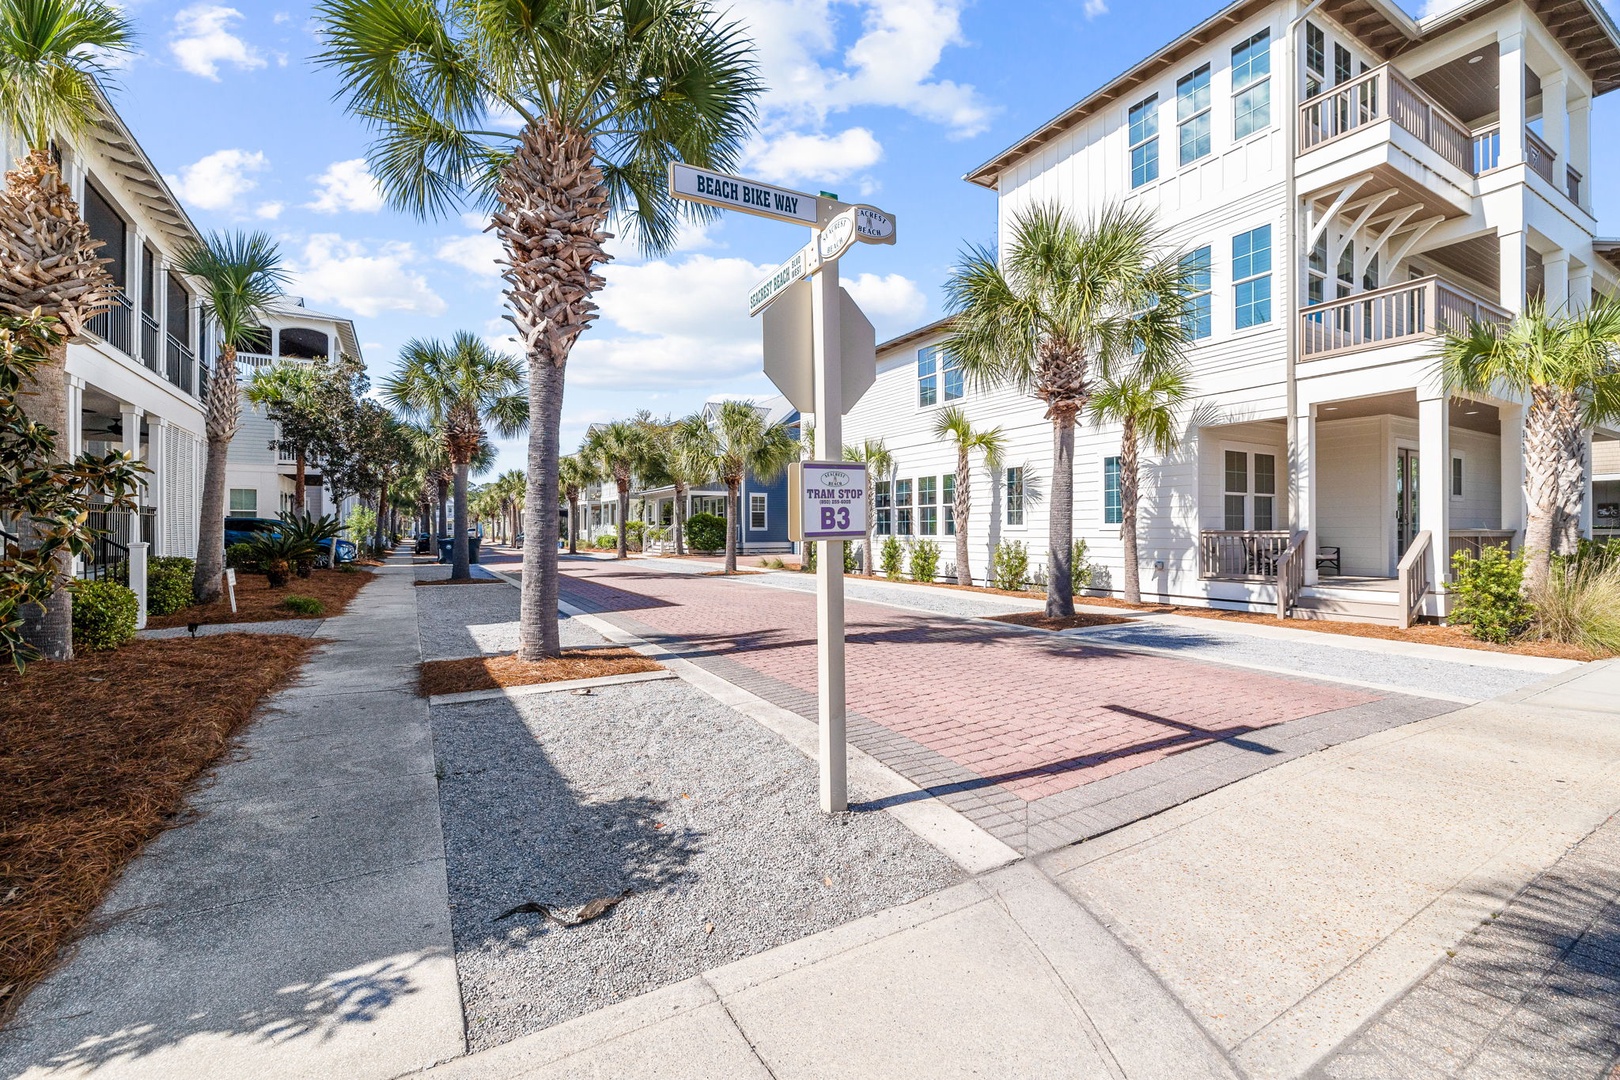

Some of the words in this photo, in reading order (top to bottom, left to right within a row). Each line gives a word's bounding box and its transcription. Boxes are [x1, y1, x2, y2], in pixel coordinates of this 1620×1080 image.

[697, 174, 739, 200] BEACH
[743, 185, 771, 208] BIKE
[774, 193, 799, 214] WAY
[857, 225, 882, 236] BEACH
[750, 280, 773, 309] SEACREST
[773, 266, 790, 291] BEACH
[806, 488, 835, 499] TRAM
[838, 488, 863, 499] STOP
[820, 506, 850, 530] B3
